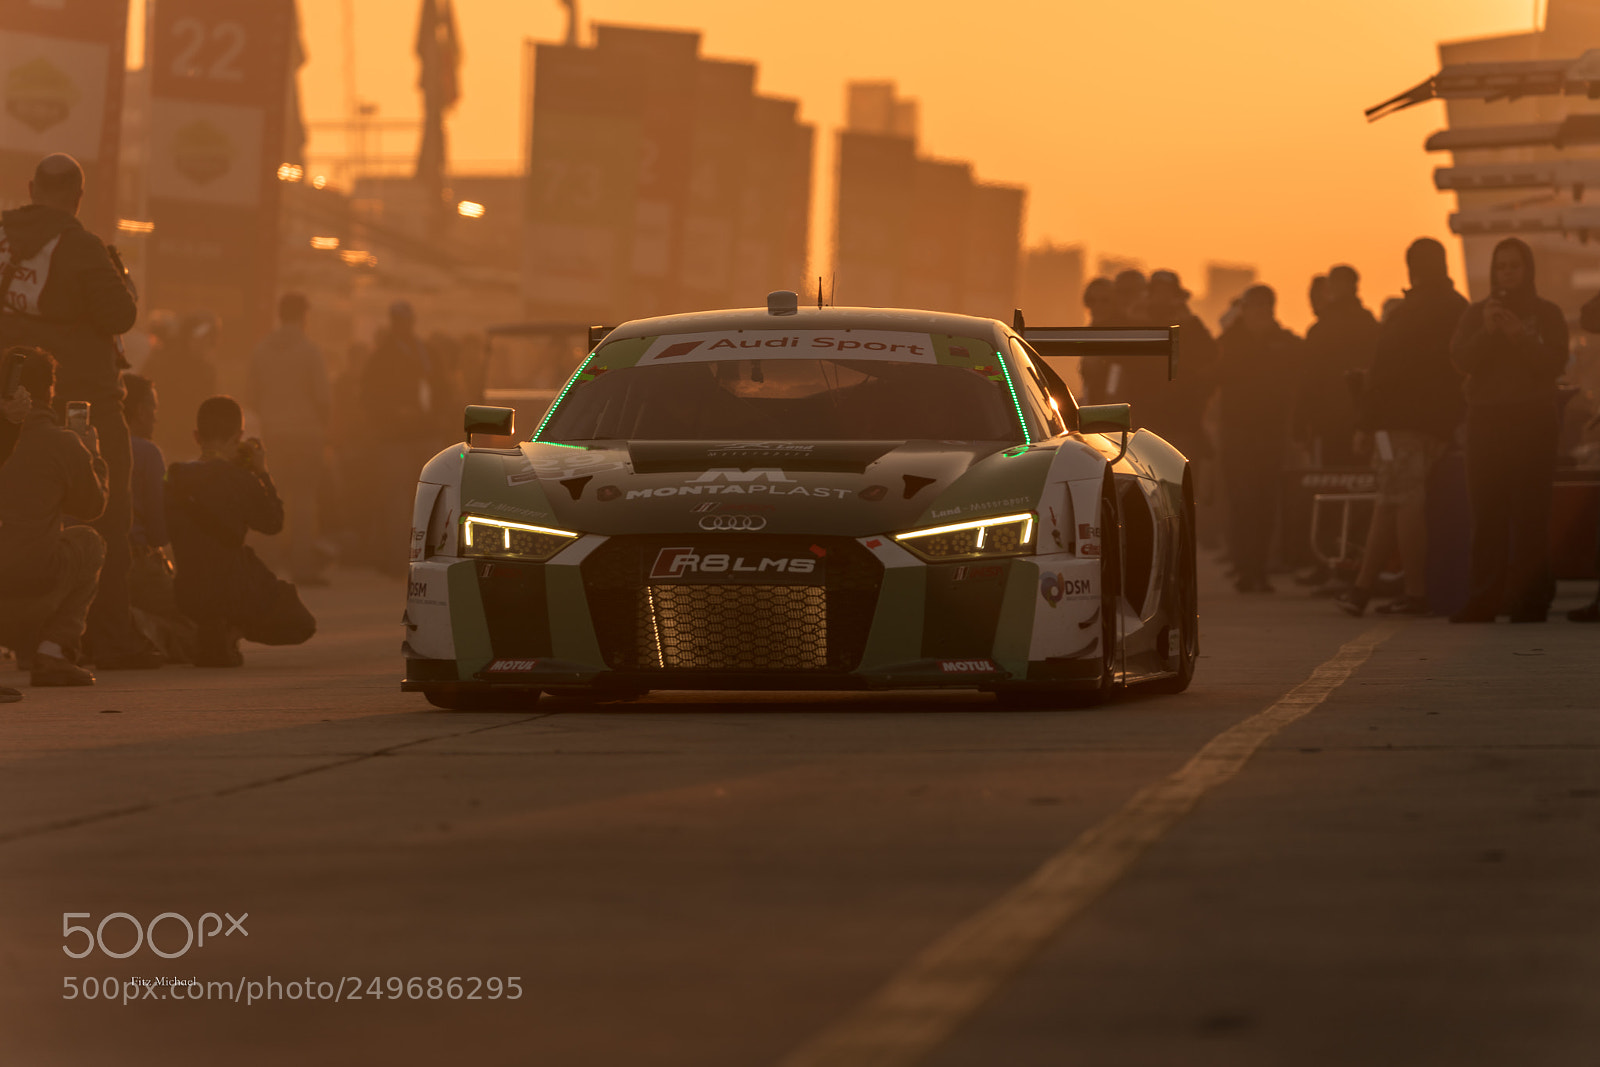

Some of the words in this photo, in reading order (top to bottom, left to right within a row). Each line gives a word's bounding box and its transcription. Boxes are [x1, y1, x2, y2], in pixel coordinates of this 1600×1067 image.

[170, 17, 246, 83] 22
[707, 337, 800, 351] Audi
[810, 337, 926, 356] Sport
[625, 485, 853, 500] MONTAPLAST
[931, 506, 961, 519] Land
[408, 582, 427, 597] DSM
[1064, 579, 1091, 595] DSM
[490, 660, 536, 671] MOTUL
[942, 660, 994, 672] MOTUL
